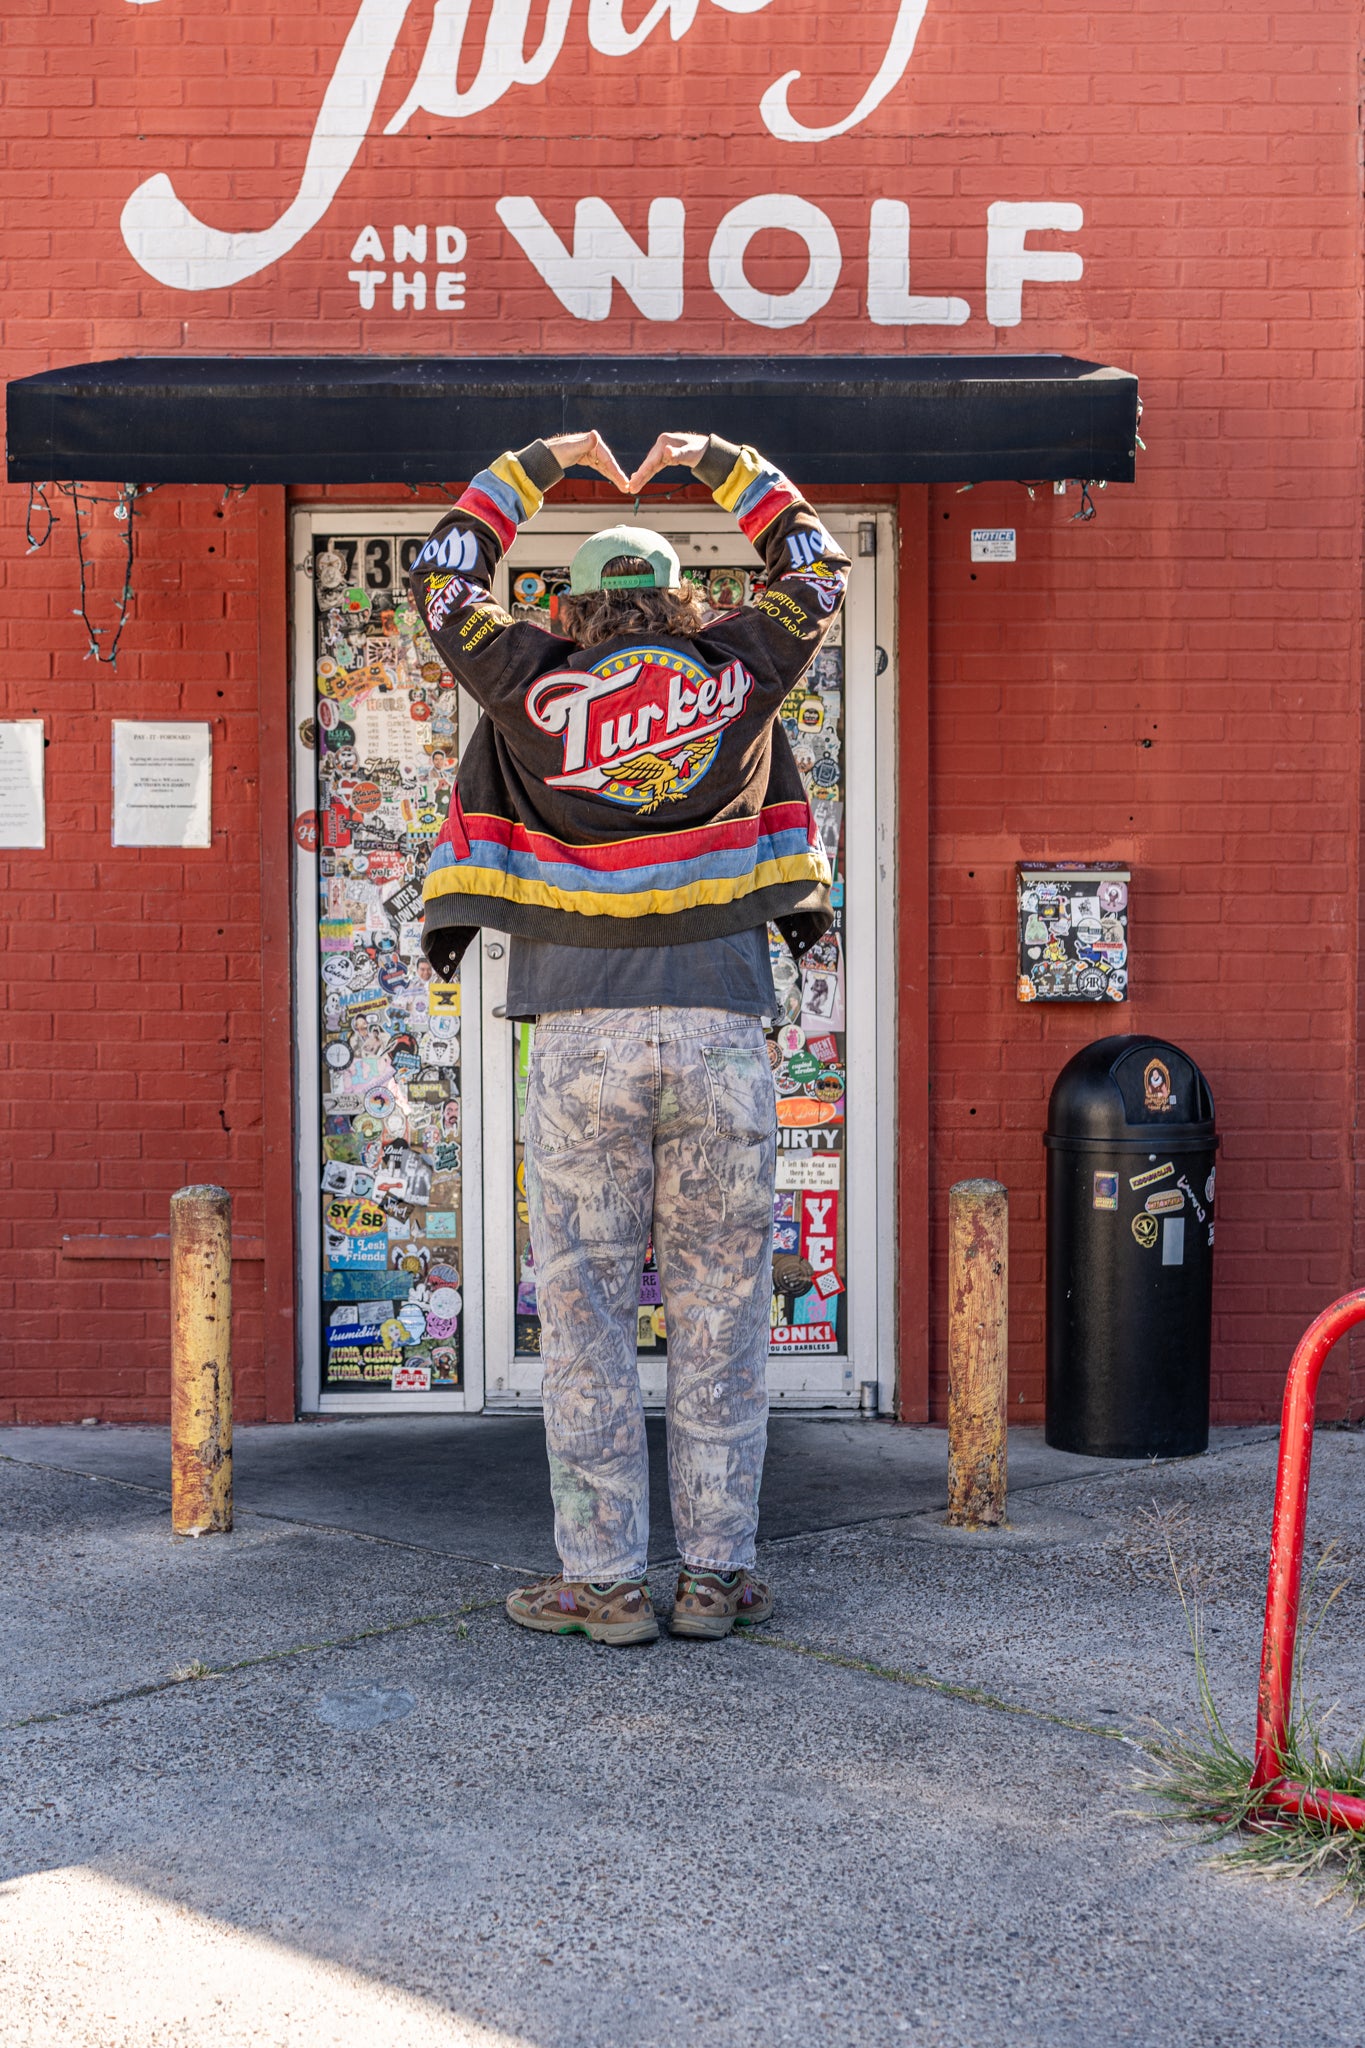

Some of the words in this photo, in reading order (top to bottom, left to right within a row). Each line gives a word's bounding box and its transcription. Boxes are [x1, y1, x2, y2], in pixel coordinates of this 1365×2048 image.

[350, 224, 467, 265] AND
[495, 193, 1085, 328] WOLF
[348, 270, 467, 312] THE
[974, 532, 1012, 541] NOTICE
[366, 698, 406, 711] HOURS
[525, 660, 755, 774] Turkey
[364, 758, 400, 774] Turkey
[371, 867, 393, 878] yelp
[391, 890, 411, 910] WTF
[406, 885, 418, 899] IS
[394, 906, 414, 925] LOW
[339, 988, 382, 1007] MAYHEM
[330, 1204, 353, 1218] SY
[361, 1212, 383, 1227] SB
[357, 1239, 386, 1251] Lesh
[346, 1251, 386, 1262] Friends
[329, 1325, 382, 1342] humidity
[395, 1373, 428, 1382] MORGAN
[558, 1591, 578, 1611] N
